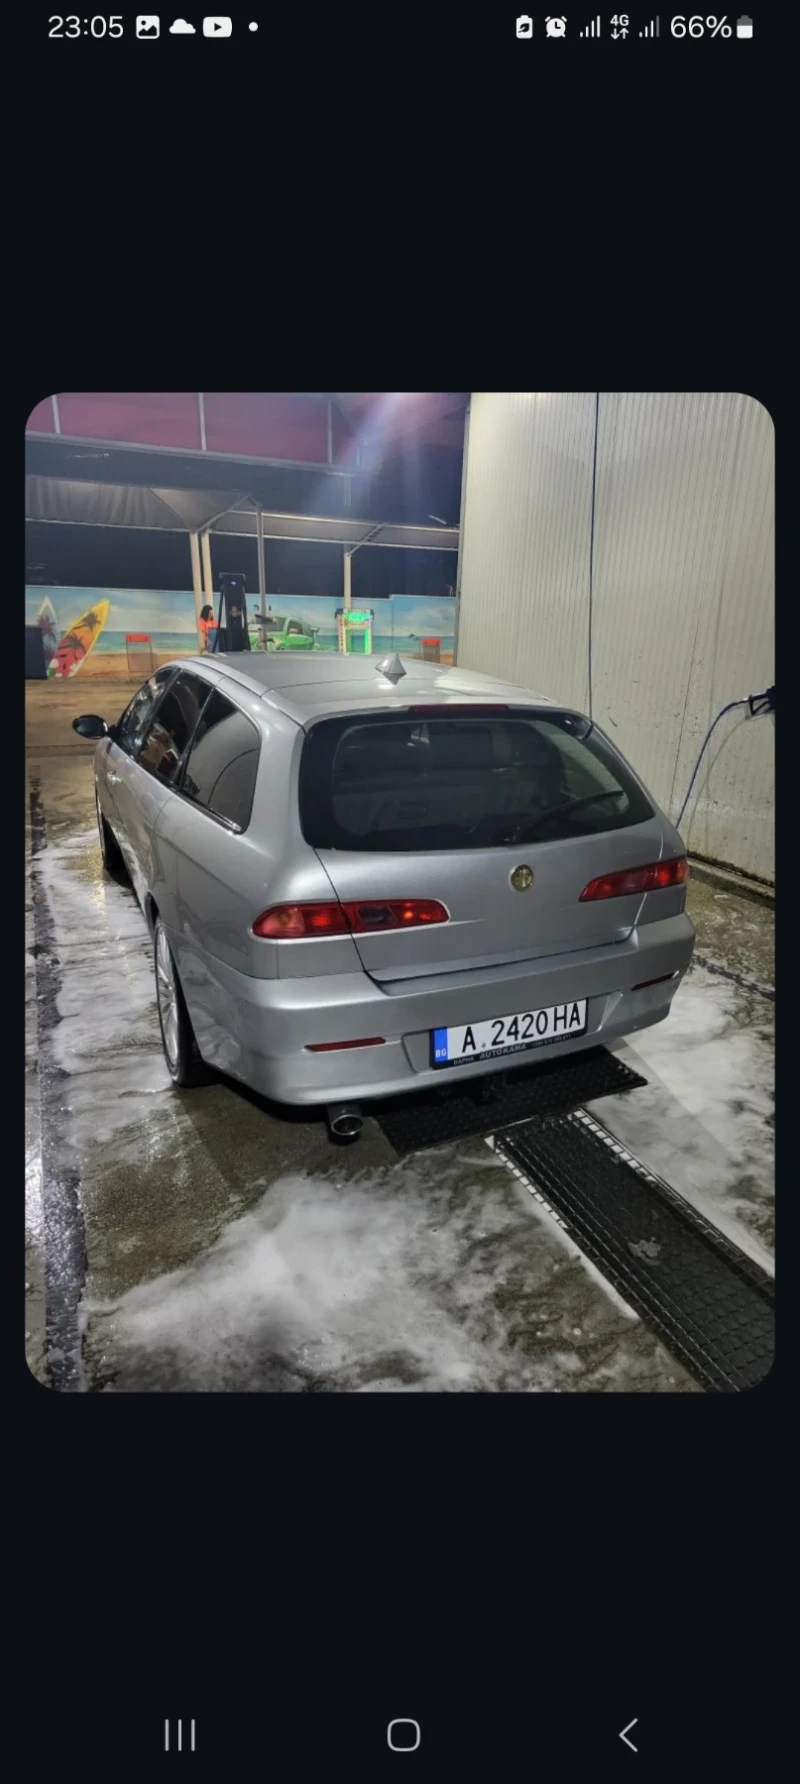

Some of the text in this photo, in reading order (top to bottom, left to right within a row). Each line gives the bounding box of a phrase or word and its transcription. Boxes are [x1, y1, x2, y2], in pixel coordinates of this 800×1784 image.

[491, 1010, 548, 1046] 2420
[553, 1002, 581, 1032] HA
[435, 1049, 447, 1058] BG
